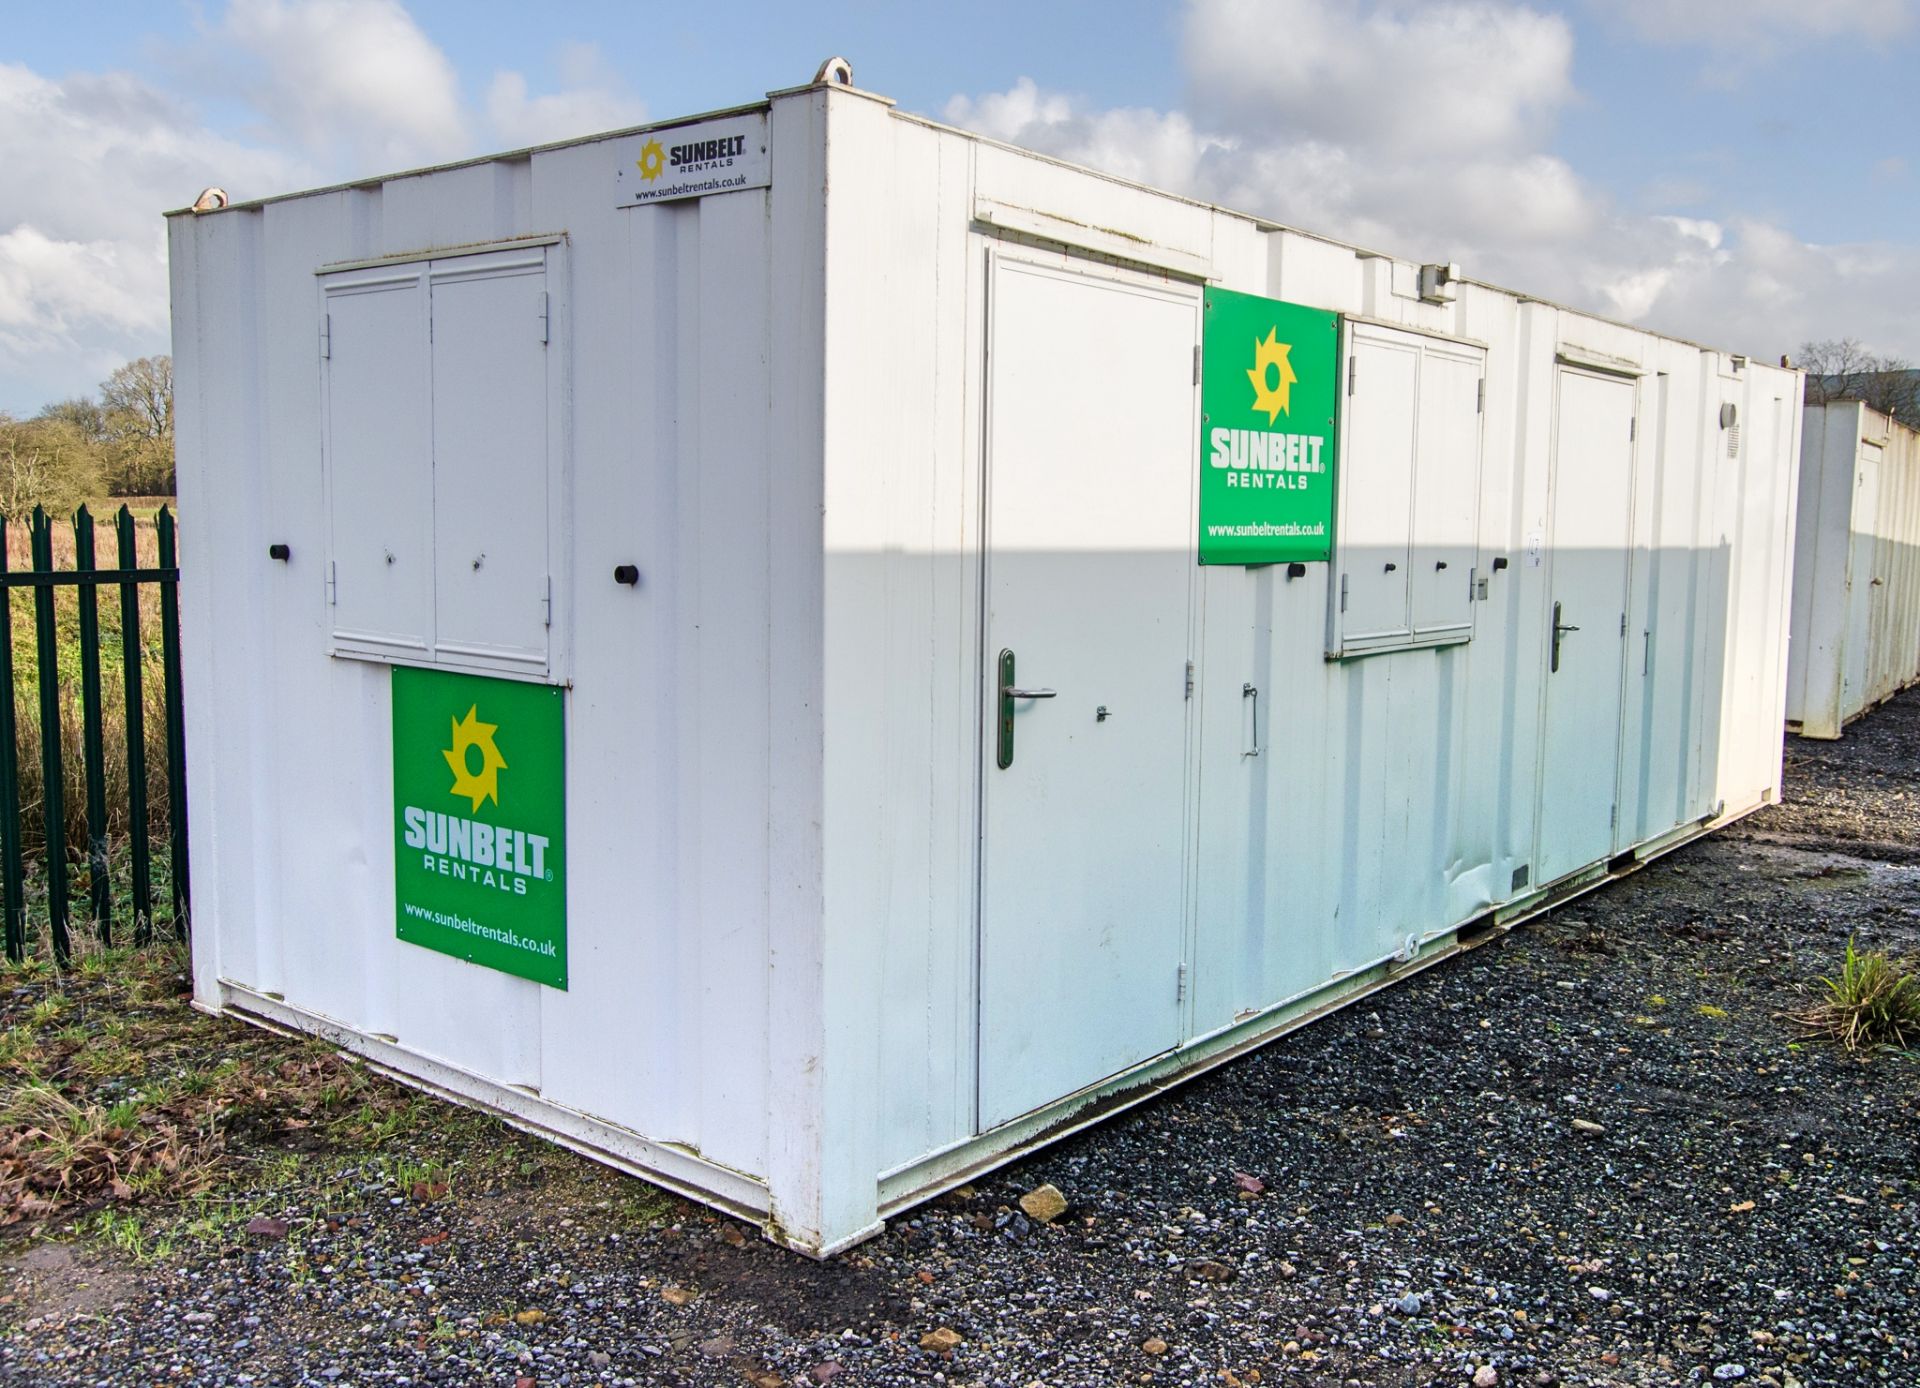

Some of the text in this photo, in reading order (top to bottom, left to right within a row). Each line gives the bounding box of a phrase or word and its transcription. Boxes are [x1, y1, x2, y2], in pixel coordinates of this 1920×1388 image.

[670, 135, 745, 166] SUNBELT
[680, 158, 734, 173] RENTALS
[635, 174, 747, 200] www.sunbeltrentals.co.uk
[1210, 427, 1324, 473] SUNBELT
[1228, 472, 1308, 490] RENTALS
[1208, 522, 1325, 537] www.sunbeltrentals.co.uk
[423, 854, 527, 895] RENTALS
[404, 903, 556, 957] www.sunbeltrentals.co.uk
